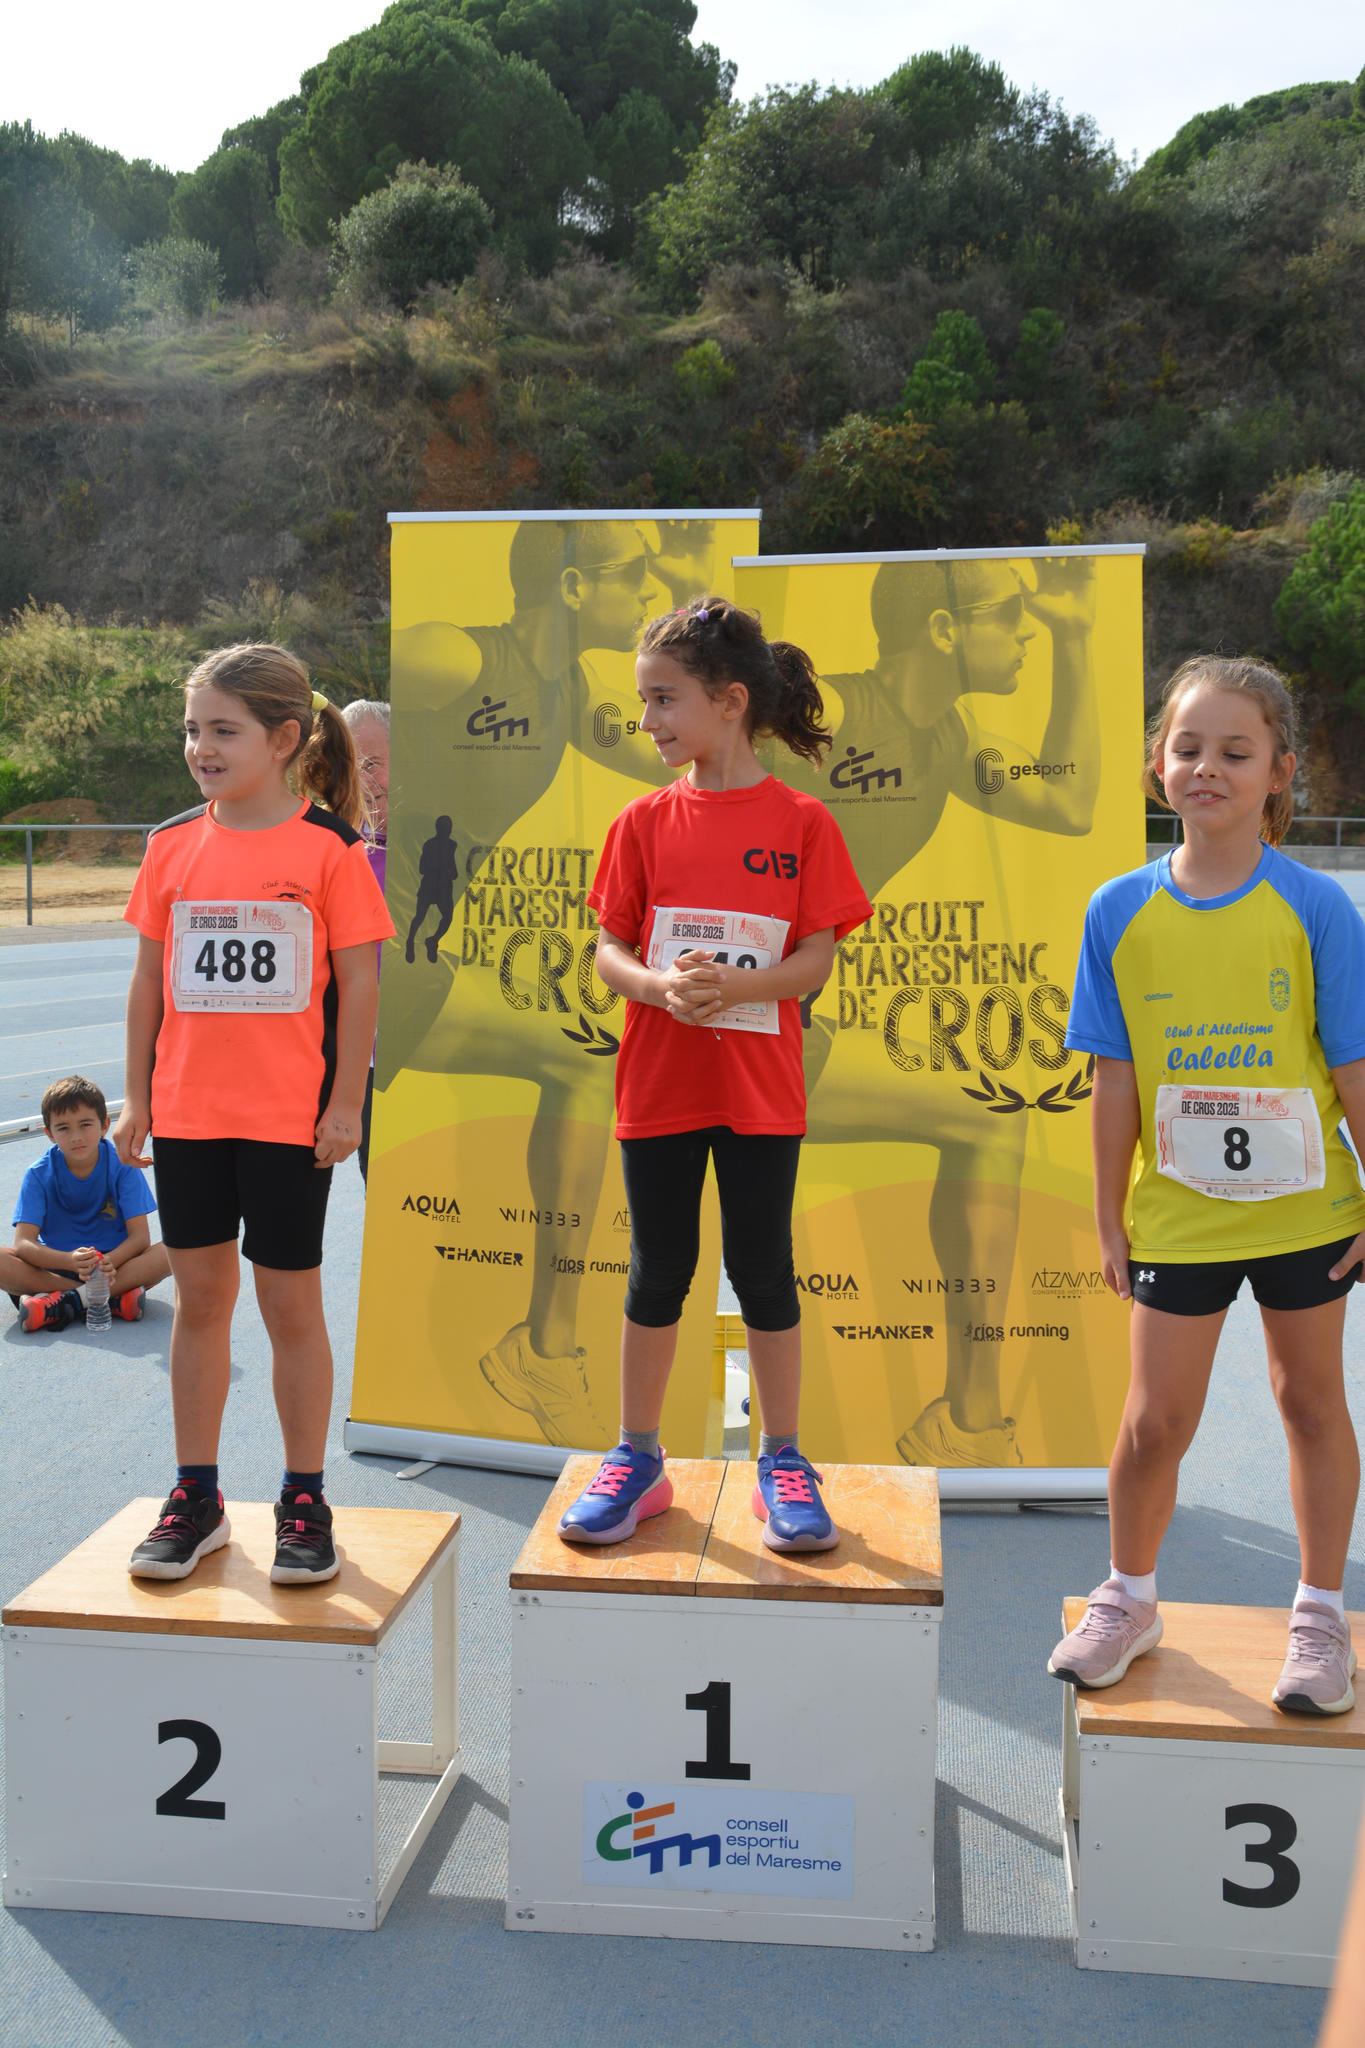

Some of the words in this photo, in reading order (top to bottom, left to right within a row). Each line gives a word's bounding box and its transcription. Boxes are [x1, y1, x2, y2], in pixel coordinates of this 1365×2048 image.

[1010, 761, 1076, 780] gesport
[465, 845, 595, 888] CIRCUIT
[191, 916, 199, 929] DE
[199, 916, 217, 929] CROS
[218, 916, 238, 929] 2025
[672, 923, 682, 937] DE
[682, 924, 702, 938] CROS
[703, 926, 725, 940] 2025
[846, 900, 984, 944] IRCUIT
[195, 939, 276, 984] 488
[461, 927, 497, 967] DE
[500, 928, 623, 1015] CRO
[838, 942, 1049, 987] MARESMENC
[838, 988, 878, 1030] DE
[884, 984, 1073, 1072] CROS
[1165, 1024, 1193, 1039] Club
[1167, 1043, 1274, 1071] Calella
[1181, 1101, 1192, 1115] DE
[1193, 1101, 1216, 1115] CROS
[1216, 1102, 1240, 1116] 2025
[1223, 1127, 1251, 1171] 8
[401, 1194, 461, 1217] AQUA
[431, 1214, 461, 1224] HOTEL
[795, 1273, 859, 1296] AQUA
[827, 1292, 860, 1300] HOTEL
[1009, 1323, 1069, 1341] running
[684, 1681, 751, 1781] 1
[156, 1718, 226, 1821] 2
[726, 1818, 788, 1833] consell
[726, 1834, 799, 1850] esportiu
[726, 1851, 751, 1866] del
[756, 1853, 842, 1871] Maresme
[1222, 1802, 1301, 1909] 3
